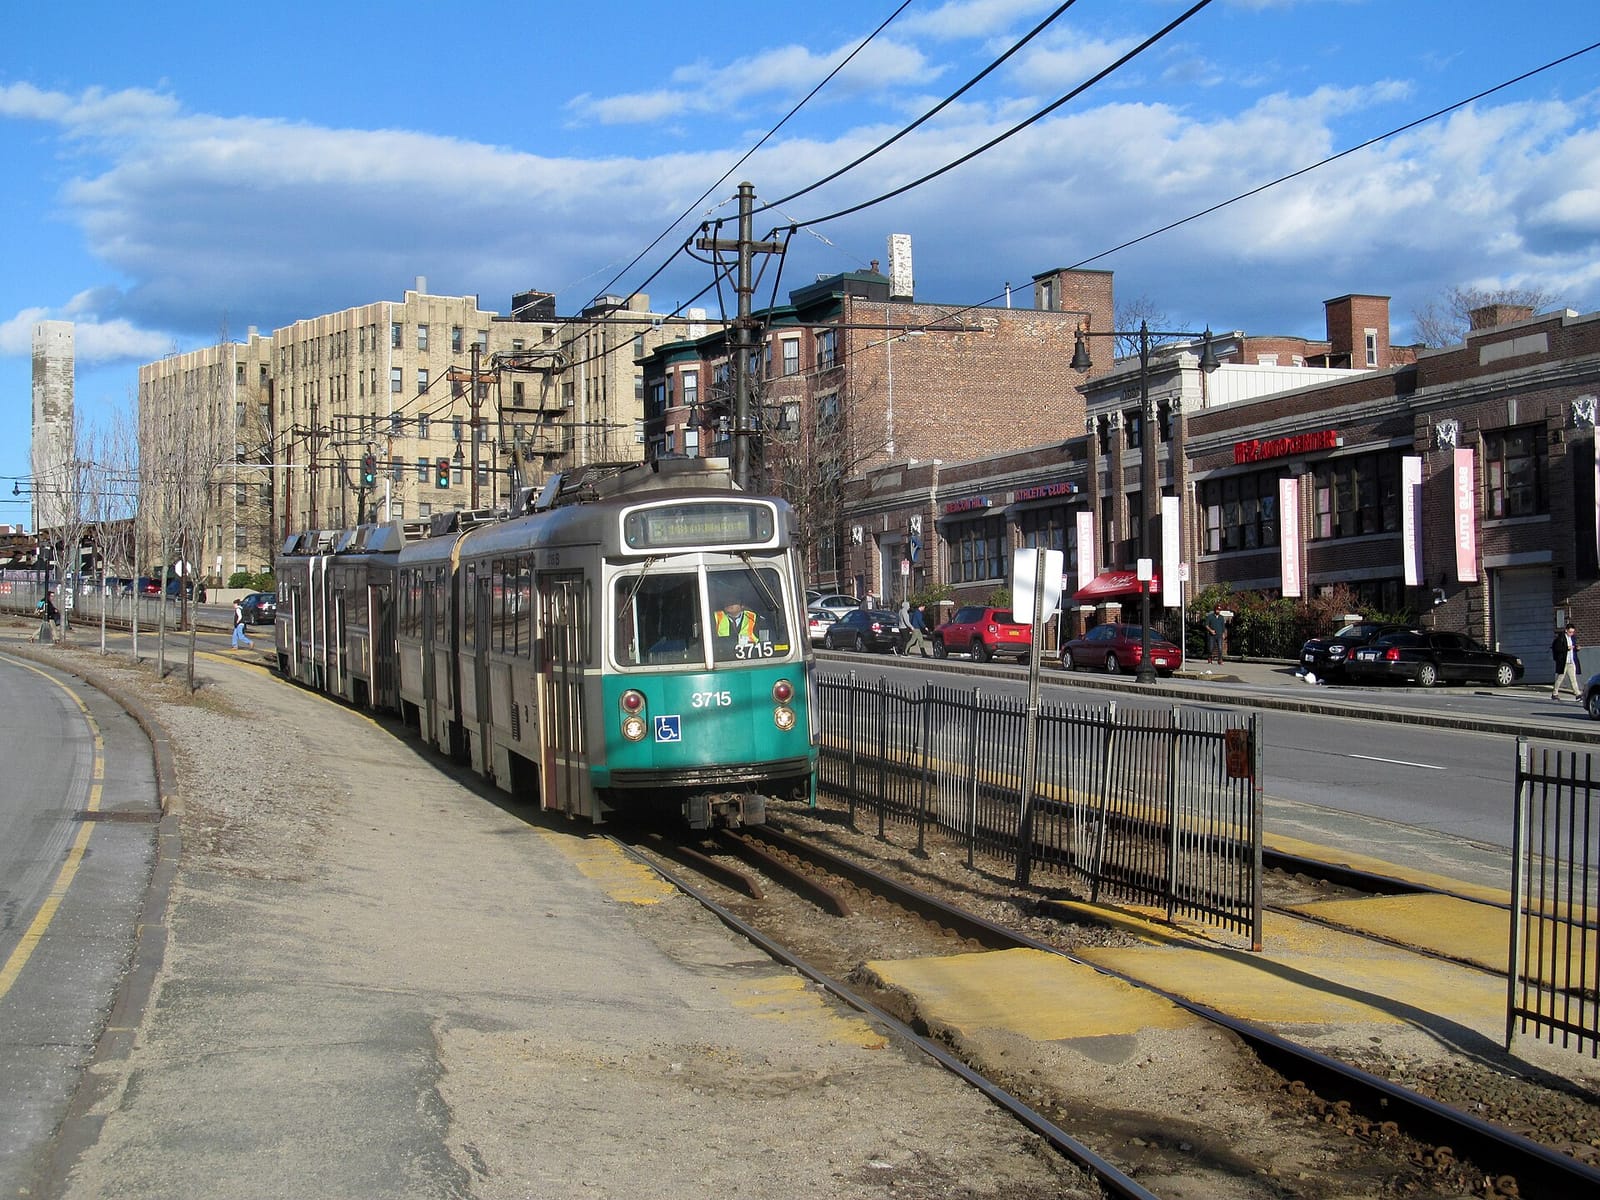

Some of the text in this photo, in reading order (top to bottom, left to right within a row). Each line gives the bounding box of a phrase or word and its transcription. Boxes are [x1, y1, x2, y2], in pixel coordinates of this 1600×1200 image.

[1261, 438, 1290, 459] AUTO
[1290, 430, 1337, 455] CENTER
[1015, 481, 1074, 501] ATHLETIC CLUBS
[1407, 477, 1417, 550] AUTO BODY
[1459, 466, 1471, 551] AUTO GLASS
[735, 641, 774, 659] 3715
[691, 691, 732, 708] 3715
